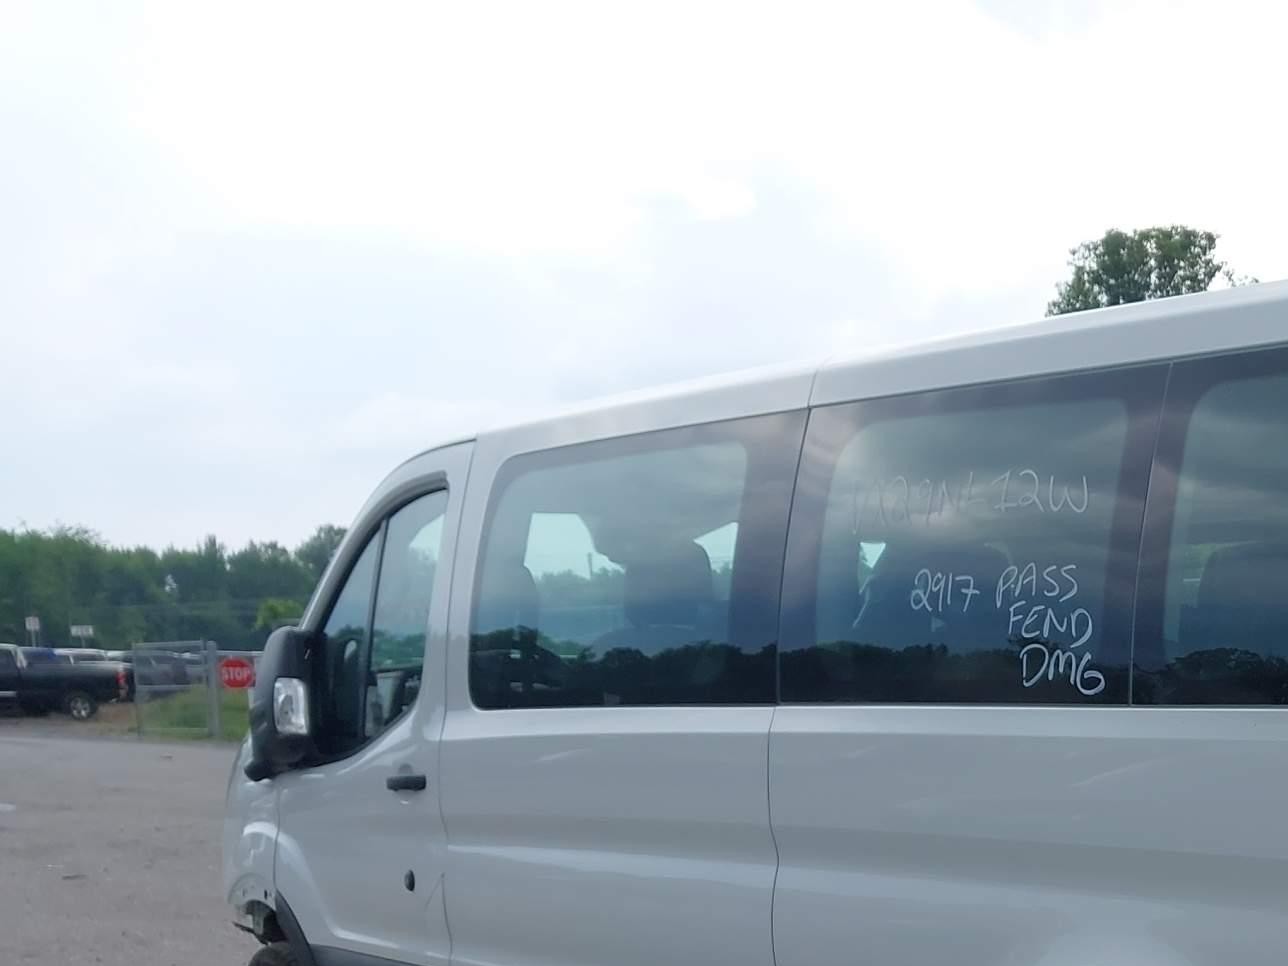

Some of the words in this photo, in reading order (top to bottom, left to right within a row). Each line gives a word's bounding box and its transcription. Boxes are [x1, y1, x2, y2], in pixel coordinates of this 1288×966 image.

[910, 568, 980, 613] 2917
[996, 562, 1078, 608] PASS
[1008, 600, 1093, 649] FEND
[221, 666, 251, 681] STOP
[1019, 643, 1106, 696] DMG
